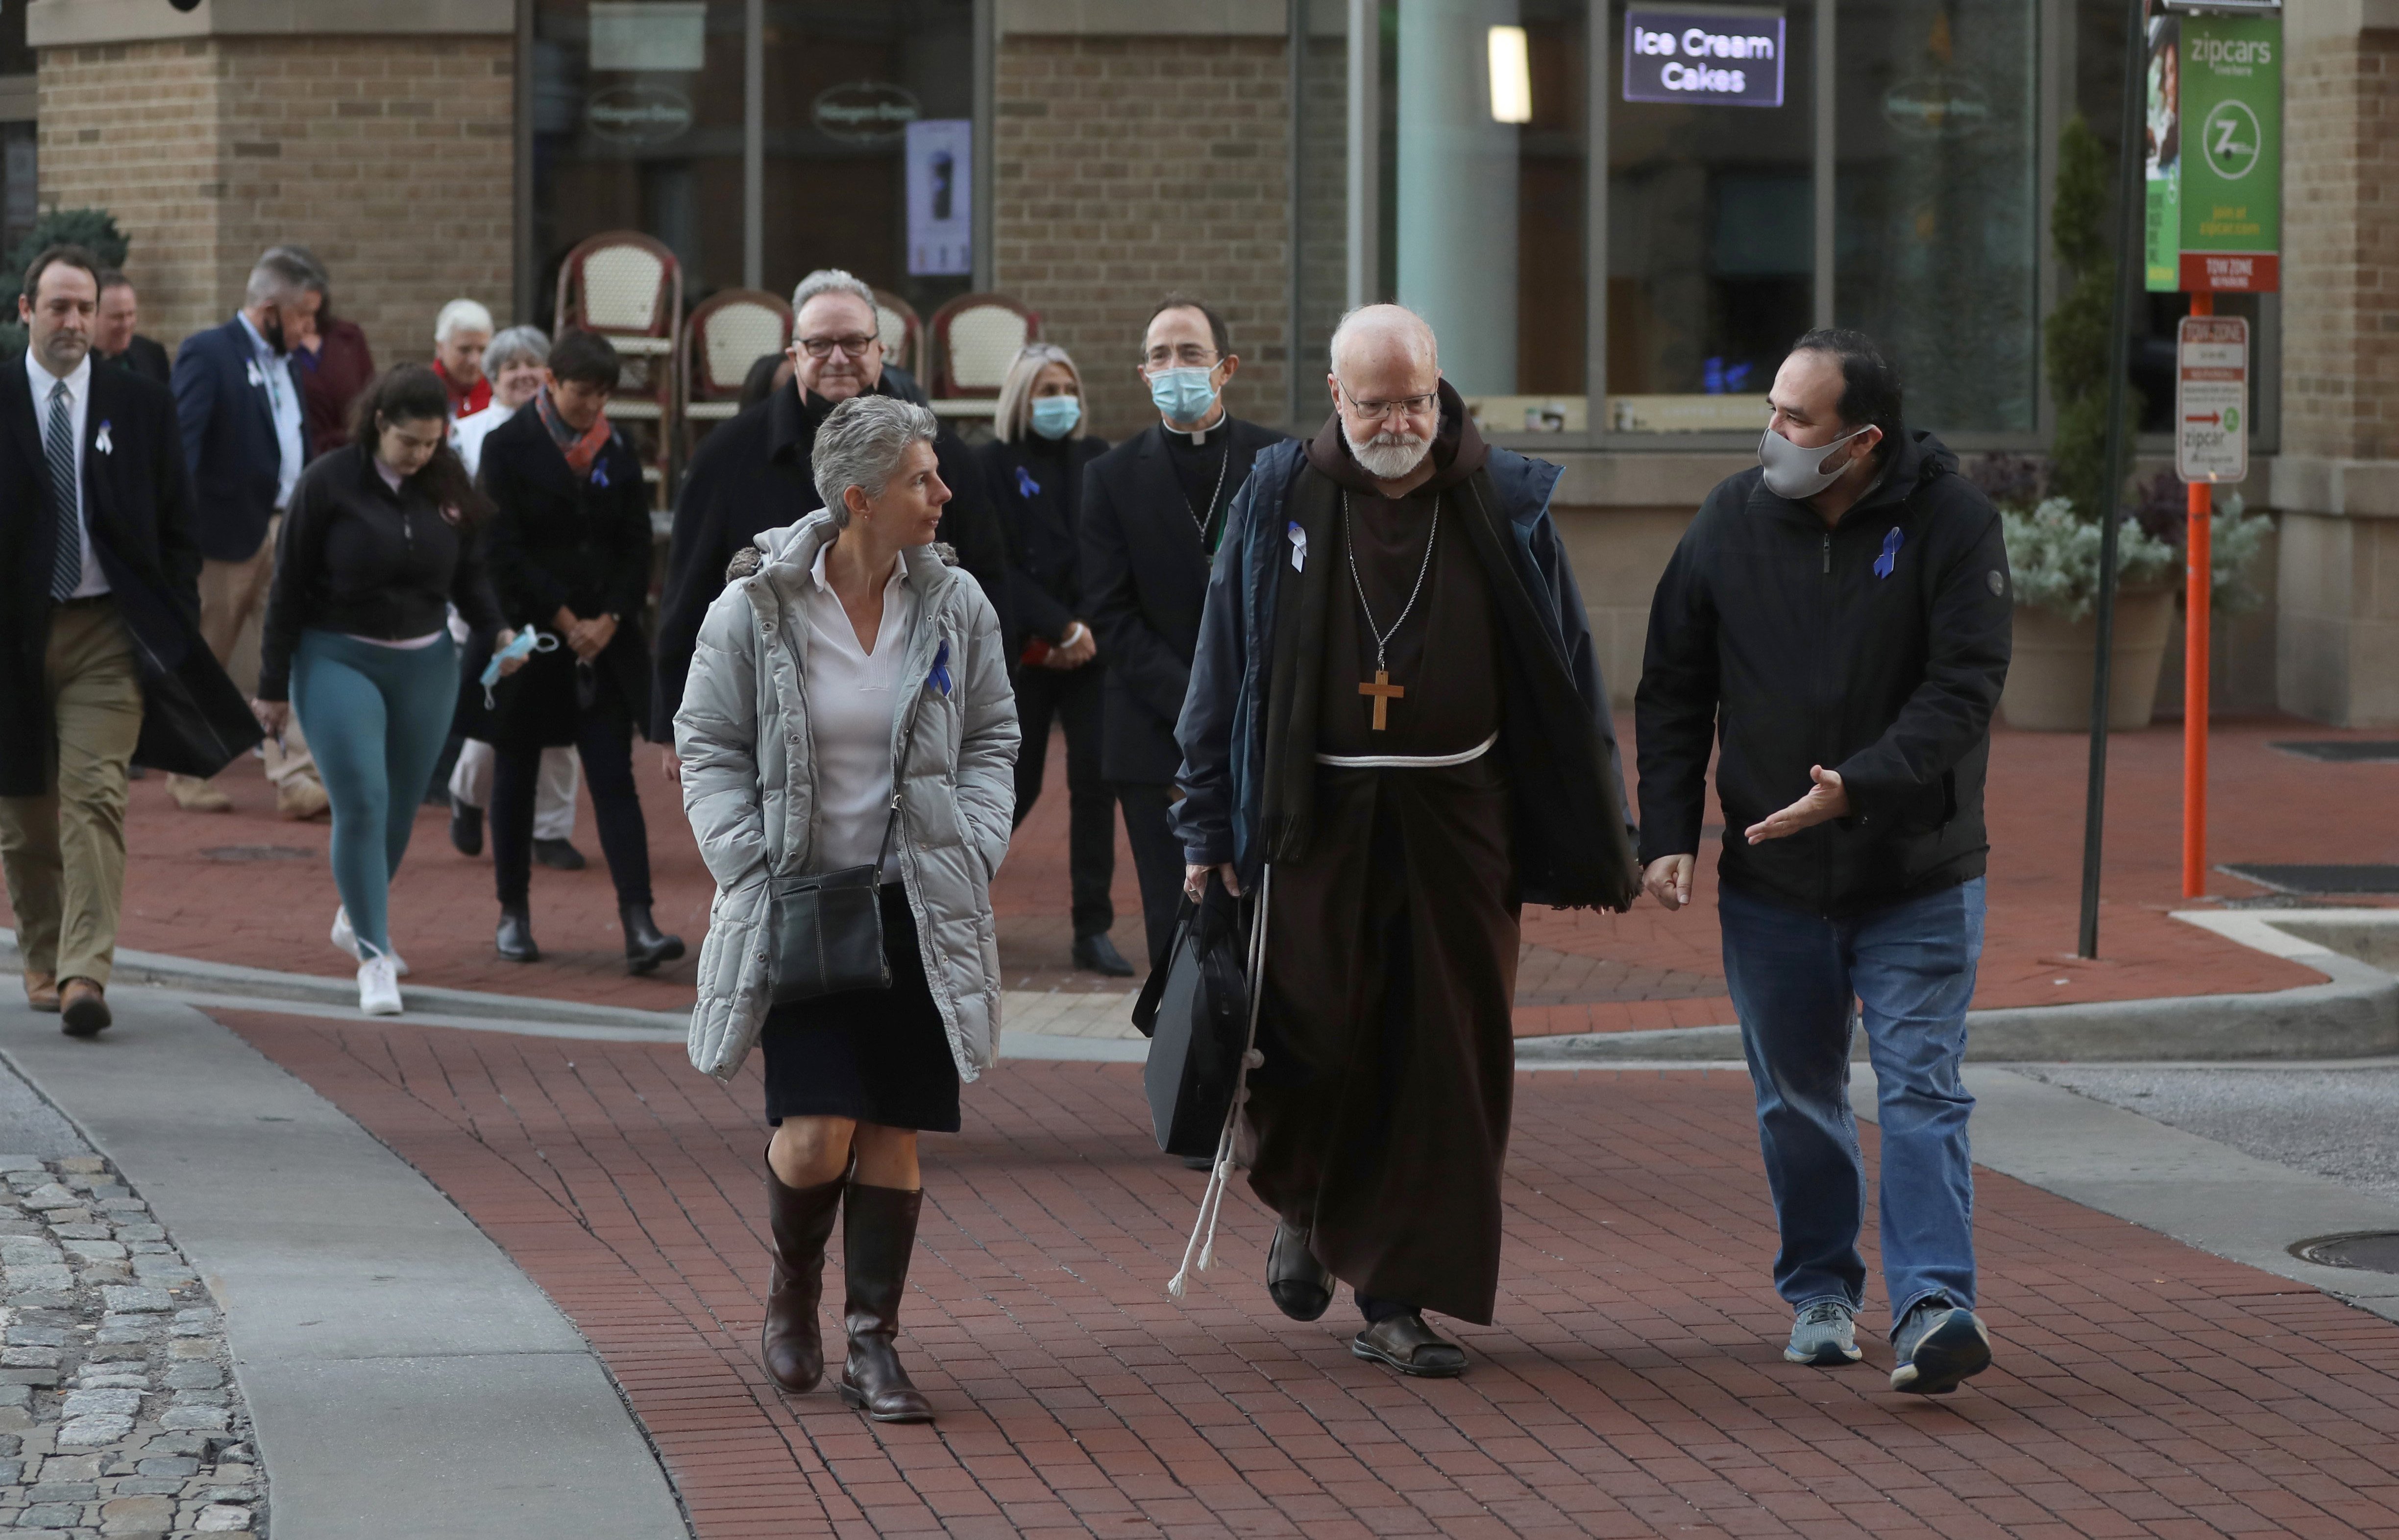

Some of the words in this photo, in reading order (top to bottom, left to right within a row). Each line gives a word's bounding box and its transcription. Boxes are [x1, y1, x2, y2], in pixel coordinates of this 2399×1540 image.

[1634, 26, 1677, 55] Ice
[1682, 28, 1774, 60] Cream
[2191, 31, 2272, 68] zipcars
[1661, 62, 1745, 93] Cakes
[2184, 427, 2225, 450] zipcar
